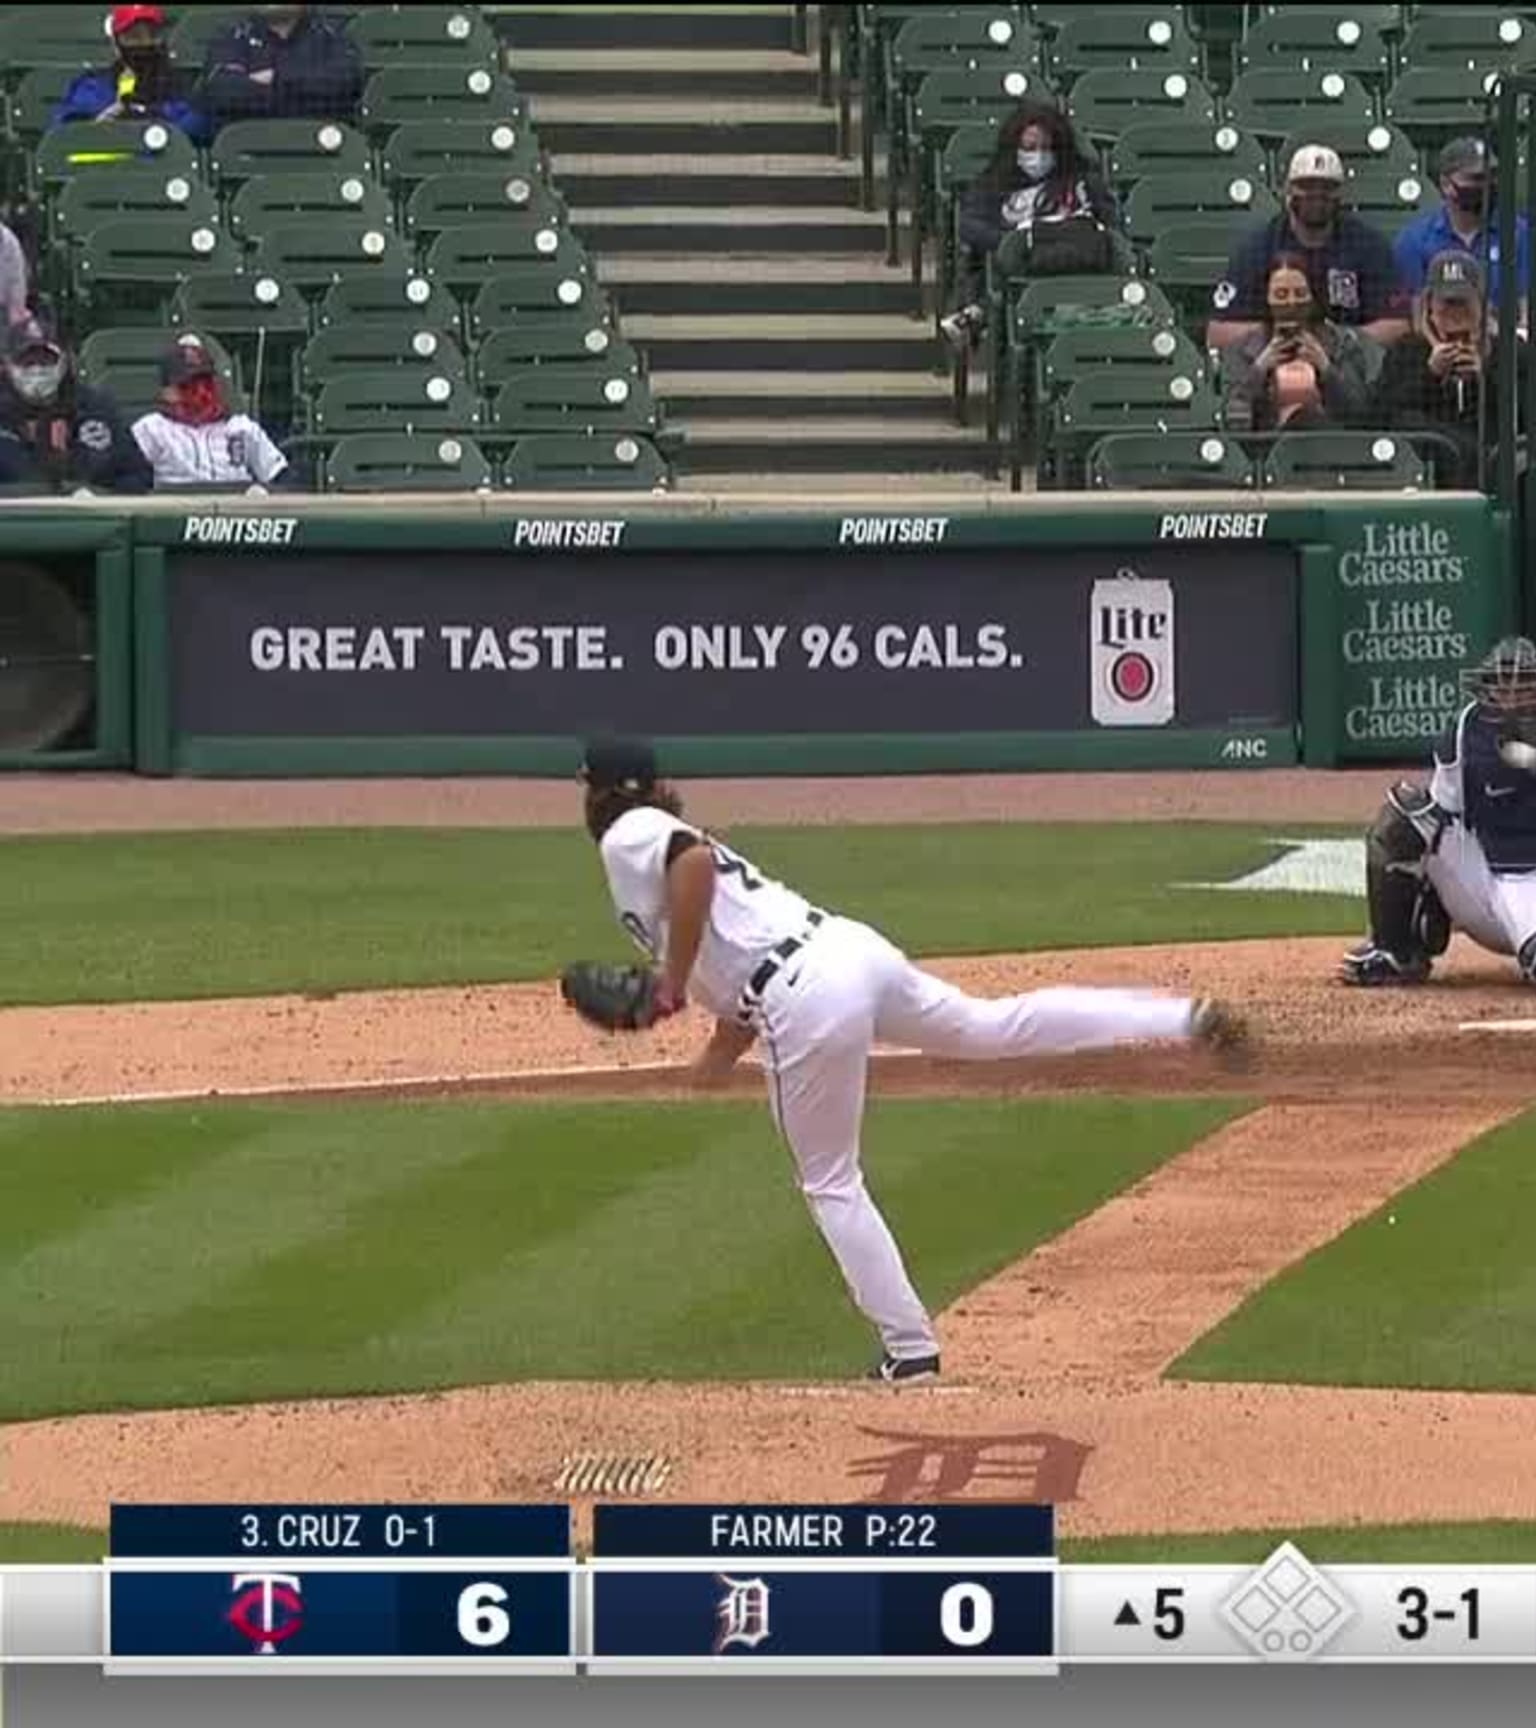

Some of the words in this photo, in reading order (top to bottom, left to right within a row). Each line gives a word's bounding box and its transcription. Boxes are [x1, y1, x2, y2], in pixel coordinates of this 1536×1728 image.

[184, 517, 298, 545] POINTSBET
[514, 520, 625, 547] POINTSBET
[839, 517, 948, 543] POINTSBET
[1160, 513, 1268, 539] POINTSBET
[1363, 521, 1449, 557] Little
[1340, 552, 1463, 586] Caesars
[1099, 605, 1167, 649] Lite
[1366, 598, 1452, 634] Little
[251, 627, 424, 670] GREAT
[441, 627, 623, 670] TASTE.
[654, 625, 787, 669] ONLY
[801, 624, 859, 667] 96
[874, 624, 1023, 668] CALS.
[1343, 629, 1467, 663] Caesars
[1370, 675, 1456, 711] Little
[1221, 738, 1267, 759] ANC
